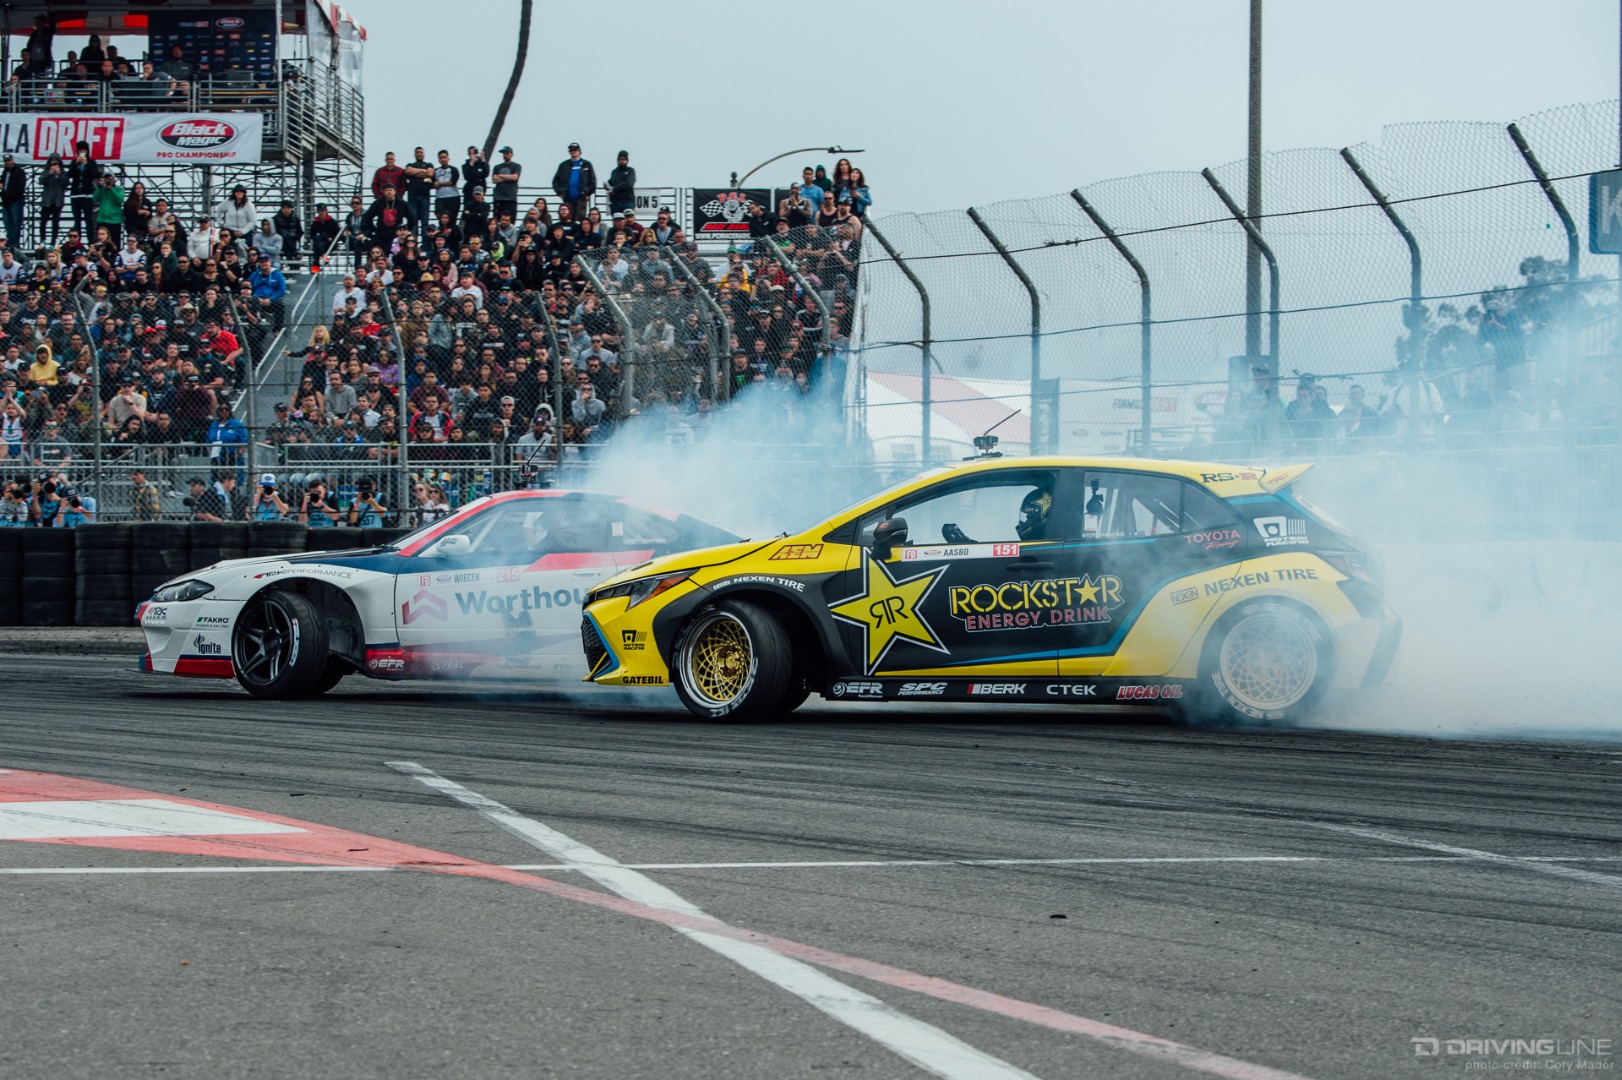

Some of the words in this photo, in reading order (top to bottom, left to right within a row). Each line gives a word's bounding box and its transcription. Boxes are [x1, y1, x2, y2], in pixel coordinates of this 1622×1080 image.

[170, 118, 228, 135] Black
[37, 120, 122, 158] DRIFT
[176, 136, 226, 147] Magic
[652, 196, 658, 208] 5
[1184, 530, 1240, 544] TOYOTA
[768, 544, 824, 560] AEM
[943, 548, 969, 557] AASBO
[994, 544, 1017, 555] 151
[453, 573, 480, 583] WIECEK
[498, 568, 519, 582] 215
[1203, 571, 1270, 596] NEXEN
[1273, 568, 1318, 582] TIRE
[777, 577, 805, 592] TIRE
[951, 577, 1121, 614] ROCKSTAR
[966, 611, 1041, 630] ENERGY
[1051, 605, 1109, 624] DRINK
[378, 659, 405, 668] EFR
[622, 676, 664, 684] GATEBIL
[900, 682, 948, 691] SPC
[846, 682, 883, 694] EFR
[980, 683, 1027, 694] BERK
[1046, 685, 1096, 695] CTEK
[1116, 685, 1159, 699] LUCAS
[1161, 685, 1183, 698] OIL
